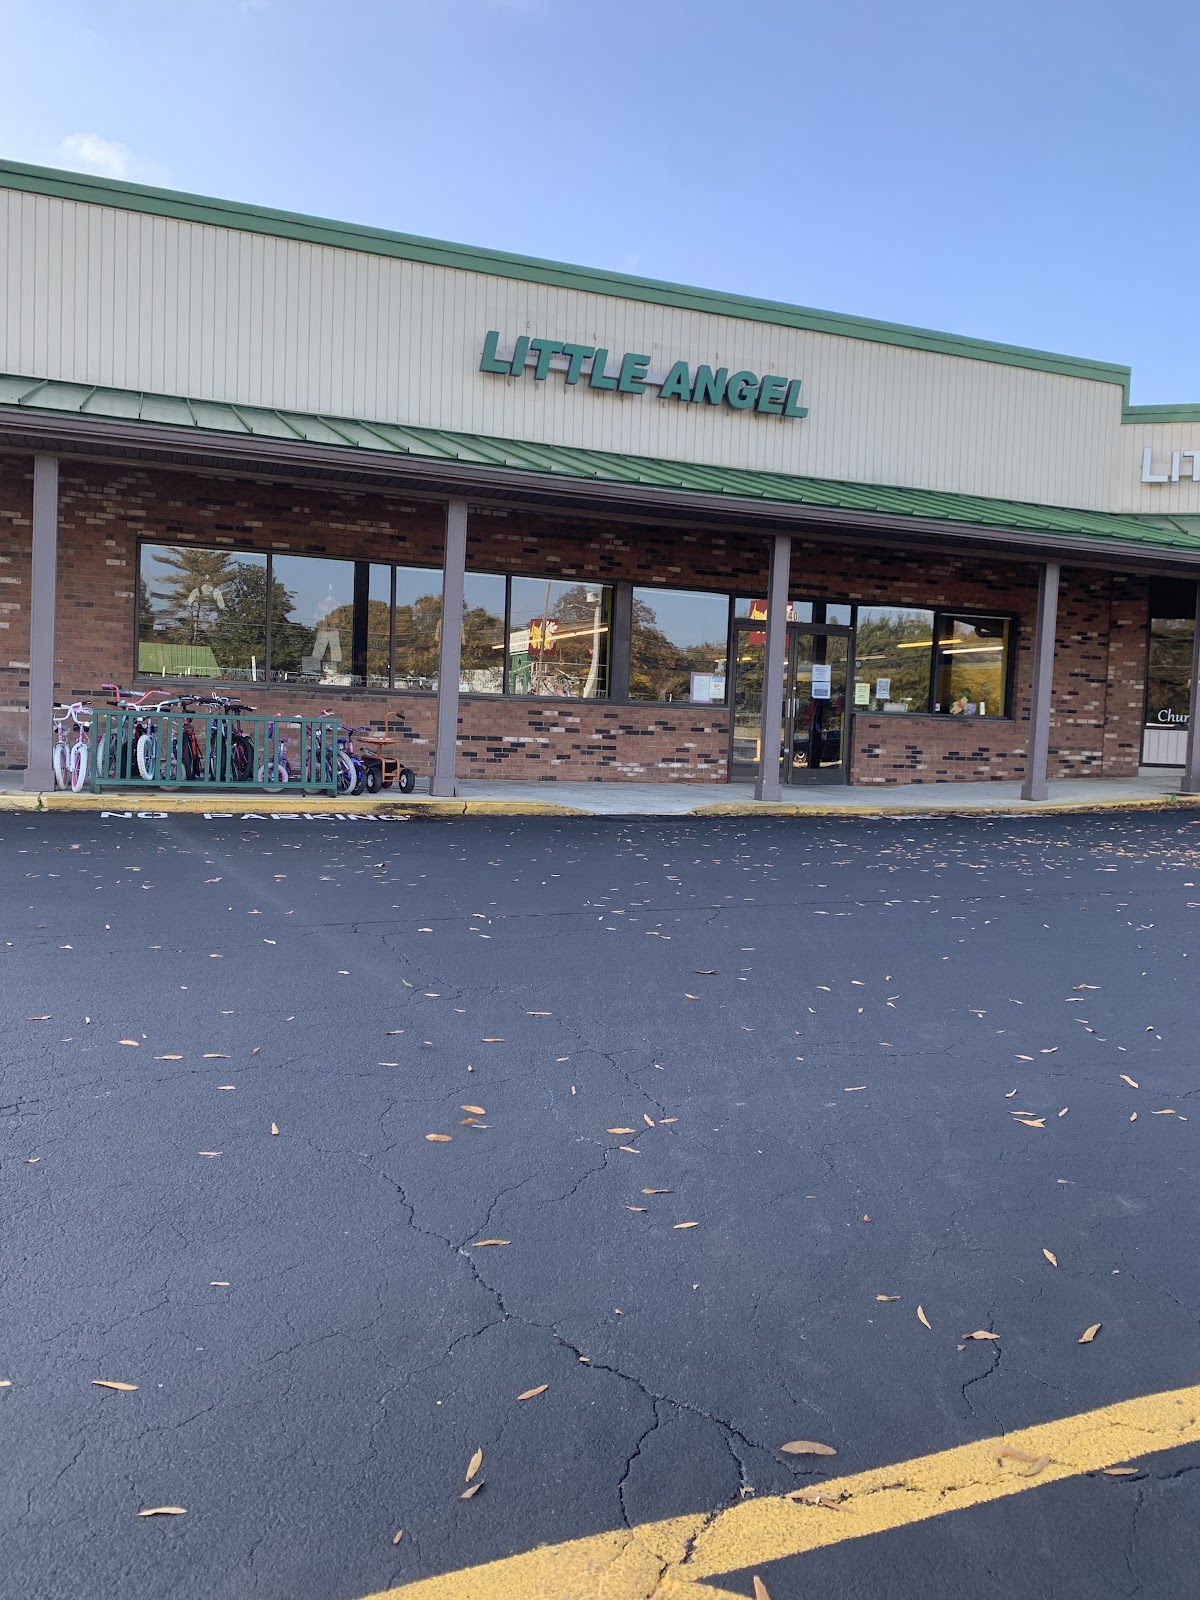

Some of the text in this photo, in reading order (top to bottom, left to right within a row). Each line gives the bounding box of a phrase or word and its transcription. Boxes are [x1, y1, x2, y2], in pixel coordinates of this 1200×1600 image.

[480, 331, 809, 418] LITTLE ANGEL
[100, 811, 411, 821] NO PARKING
